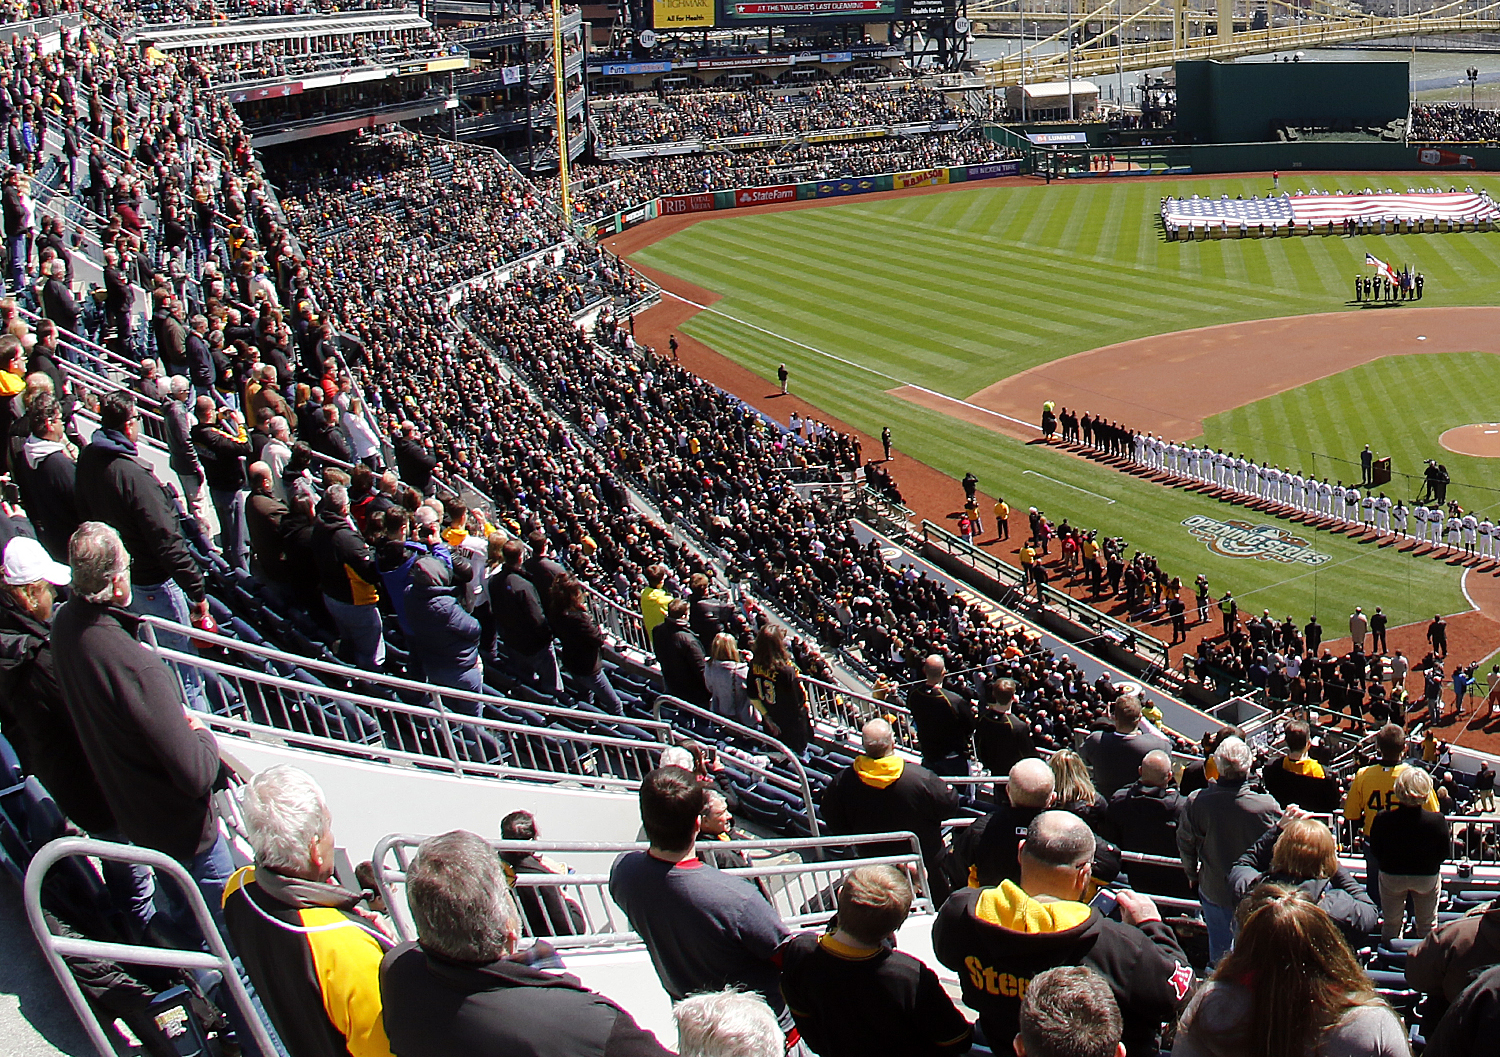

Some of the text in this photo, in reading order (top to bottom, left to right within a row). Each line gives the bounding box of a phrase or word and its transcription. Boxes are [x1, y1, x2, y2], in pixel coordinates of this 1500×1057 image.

[910, 7, 928, 15] Health
[641, 34, 655, 43] Lite
[1002, 163, 1016, 171] TIRE
[1184, 515, 1330, 564] OPENING SERIES
[755, 678, 777, 704] 13
